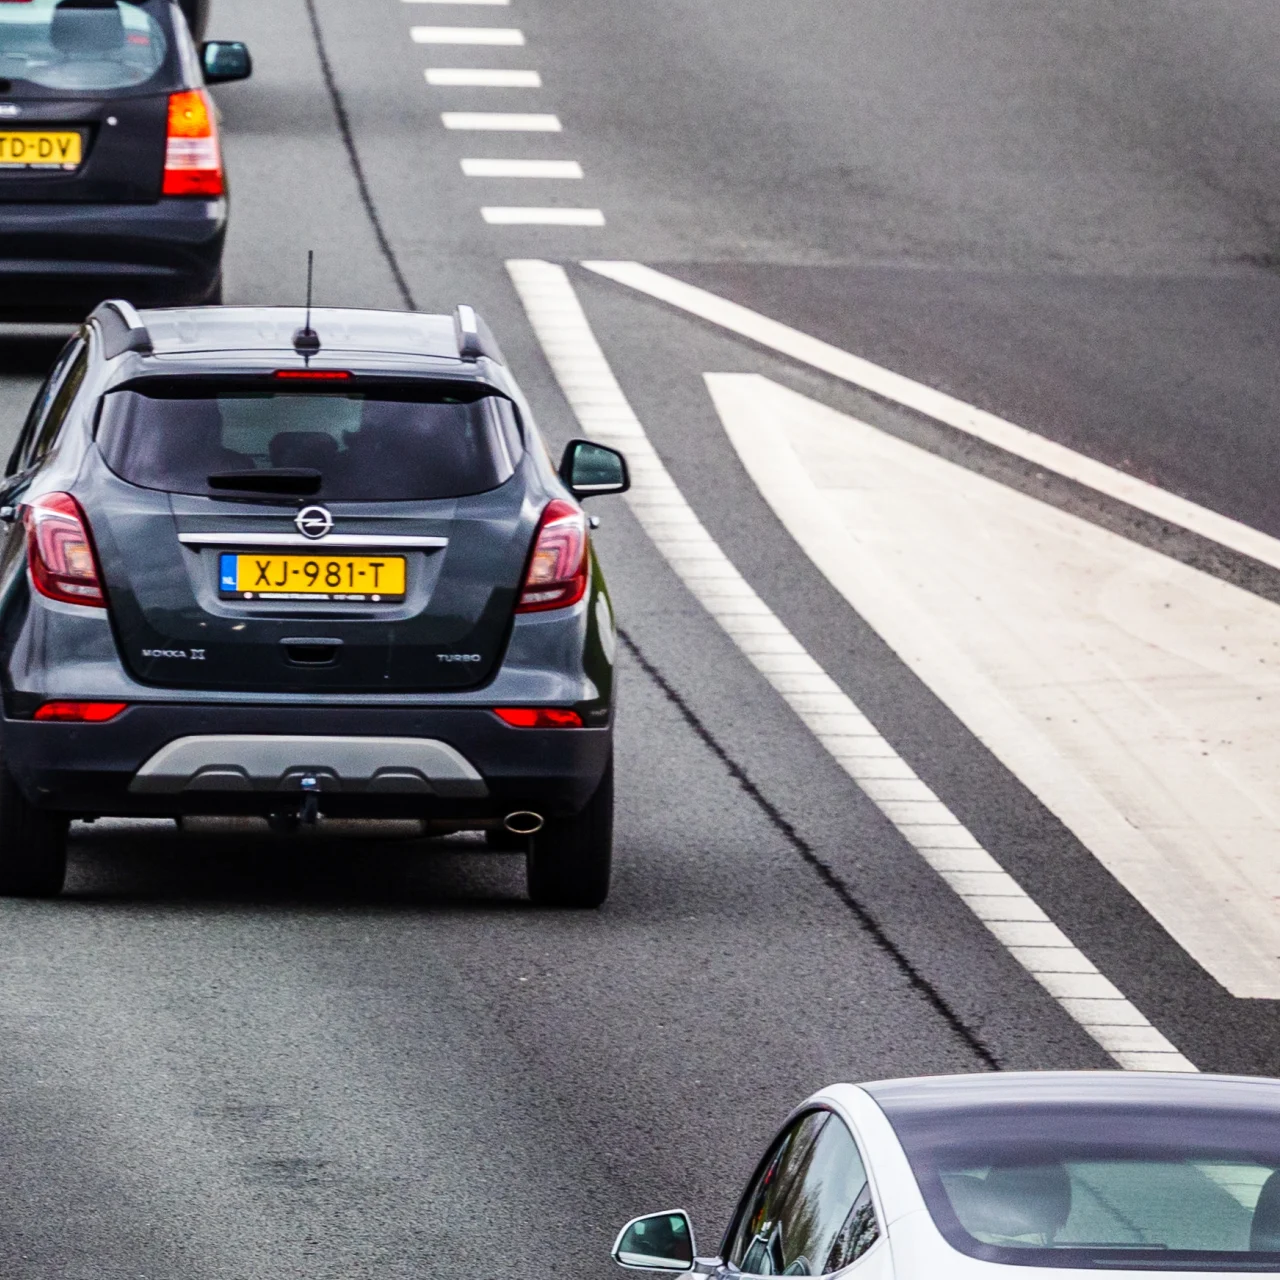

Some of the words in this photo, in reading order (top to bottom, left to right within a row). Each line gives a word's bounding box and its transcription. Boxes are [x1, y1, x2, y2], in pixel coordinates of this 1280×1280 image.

[255, 560, 385, 588] XJ-981-T
[142, 648, 187, 658] MOKKA
[436, 653, 482, 662] TURBO
